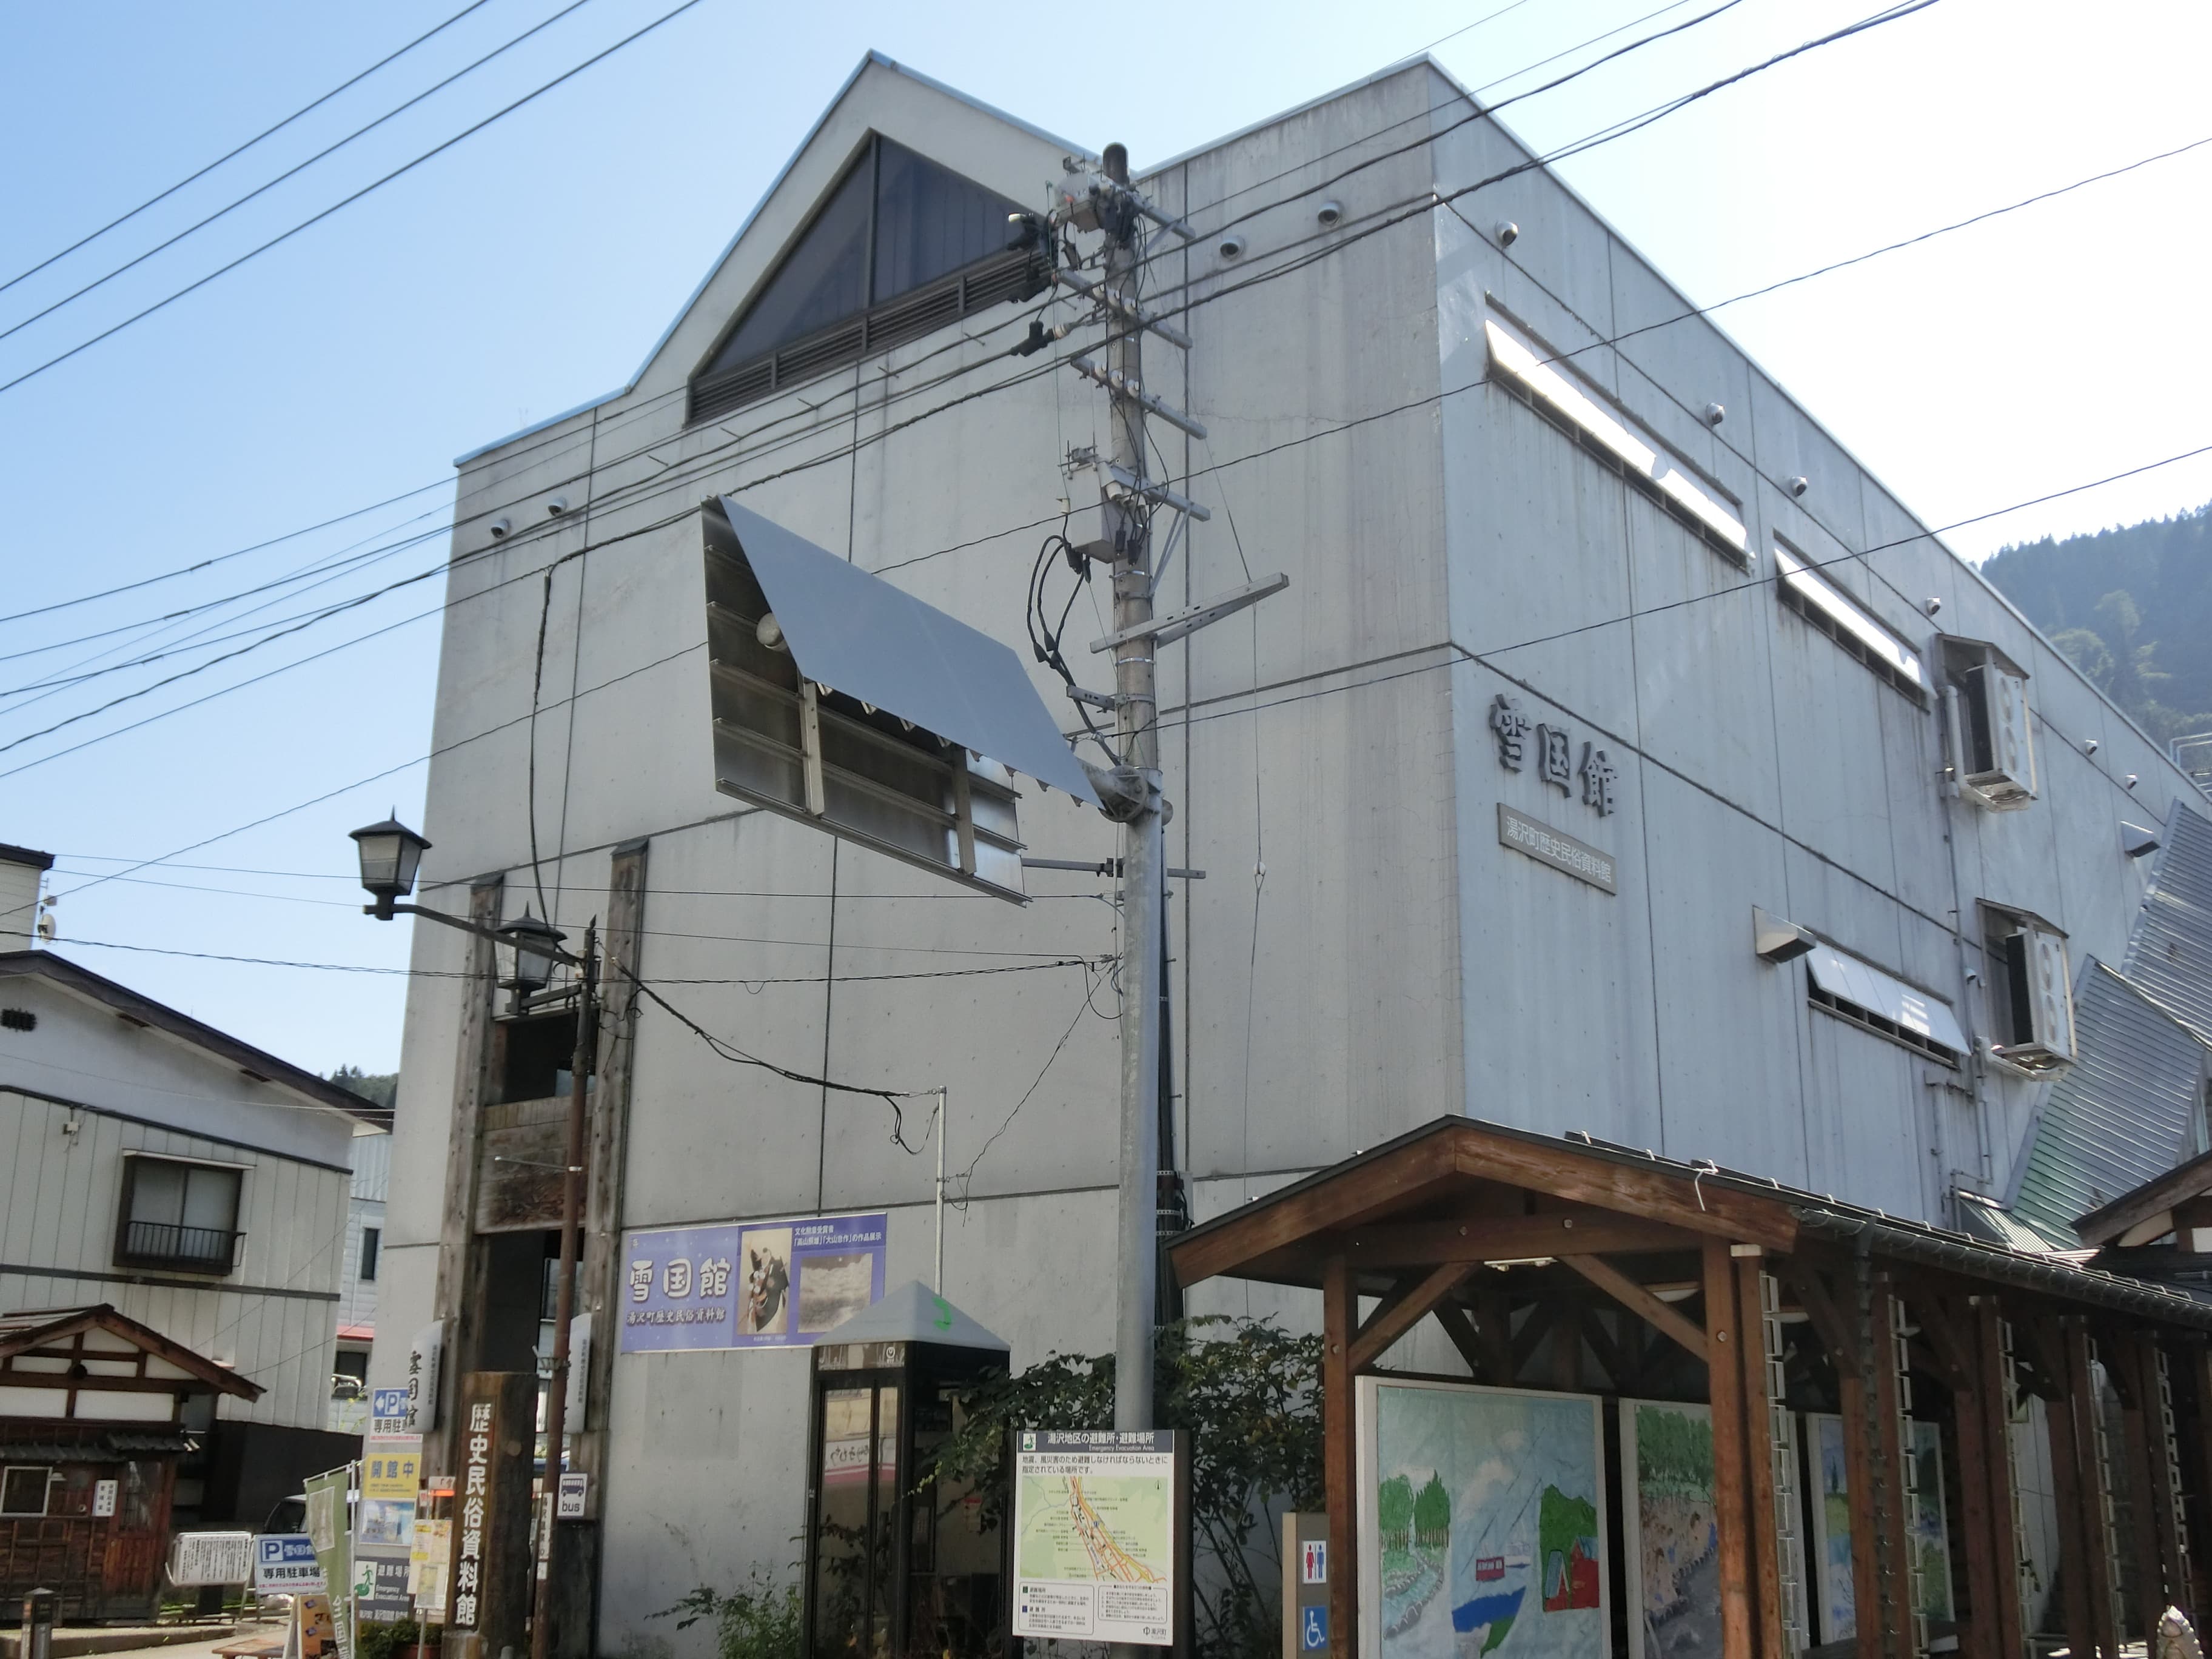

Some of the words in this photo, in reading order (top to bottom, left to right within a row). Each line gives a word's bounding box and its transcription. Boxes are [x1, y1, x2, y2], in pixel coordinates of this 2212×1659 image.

[1489, 694, 1618, 817] 雪国館
[1506, 815, 1612, 884] 湯沢町歴史民俗資料館
[629, 1257, 732, 1304] 雪国館
[387, 1394, 398, 1413] P
[370, 1460, 414, 1478] 開館中
[455, 1403, 492, 1626] 歴史民俗資料館
[561, 1501, 580, 1512] bus
[264, 1542, 280, 1560] P
[263, 1567, 321, 1579] 専用駐車場
[376, 1584, 400, 1594] Emergency
